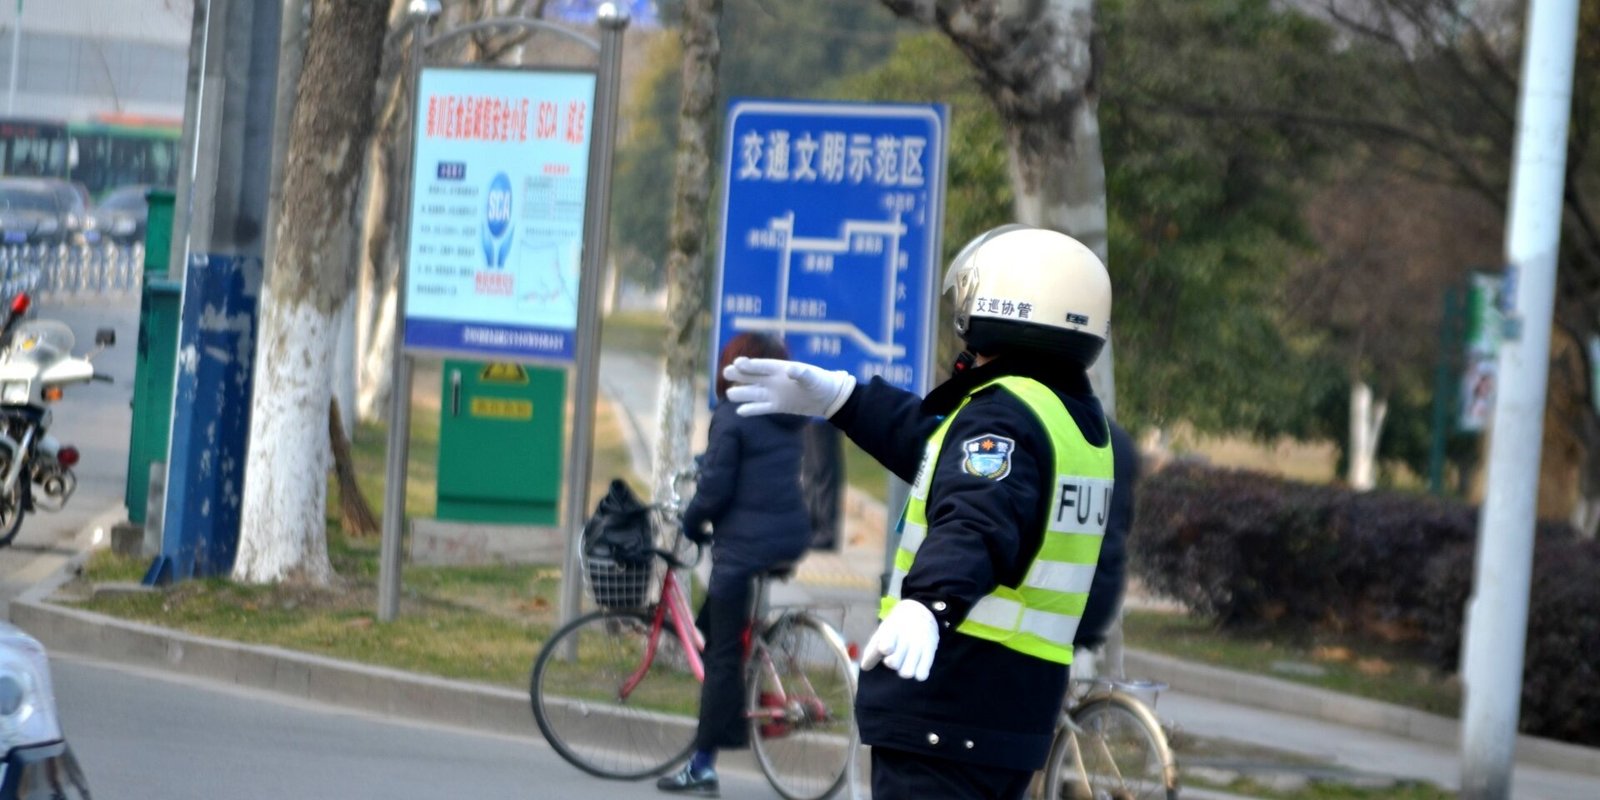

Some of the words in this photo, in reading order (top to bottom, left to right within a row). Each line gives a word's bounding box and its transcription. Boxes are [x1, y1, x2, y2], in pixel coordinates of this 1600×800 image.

[738, 129, 927, 186] 交通文明示范区
[488, 190, 511, 221] SCA
[976, 297, 1032, 319] 交巡协管
[1057, 484, 1092, 525] FU
